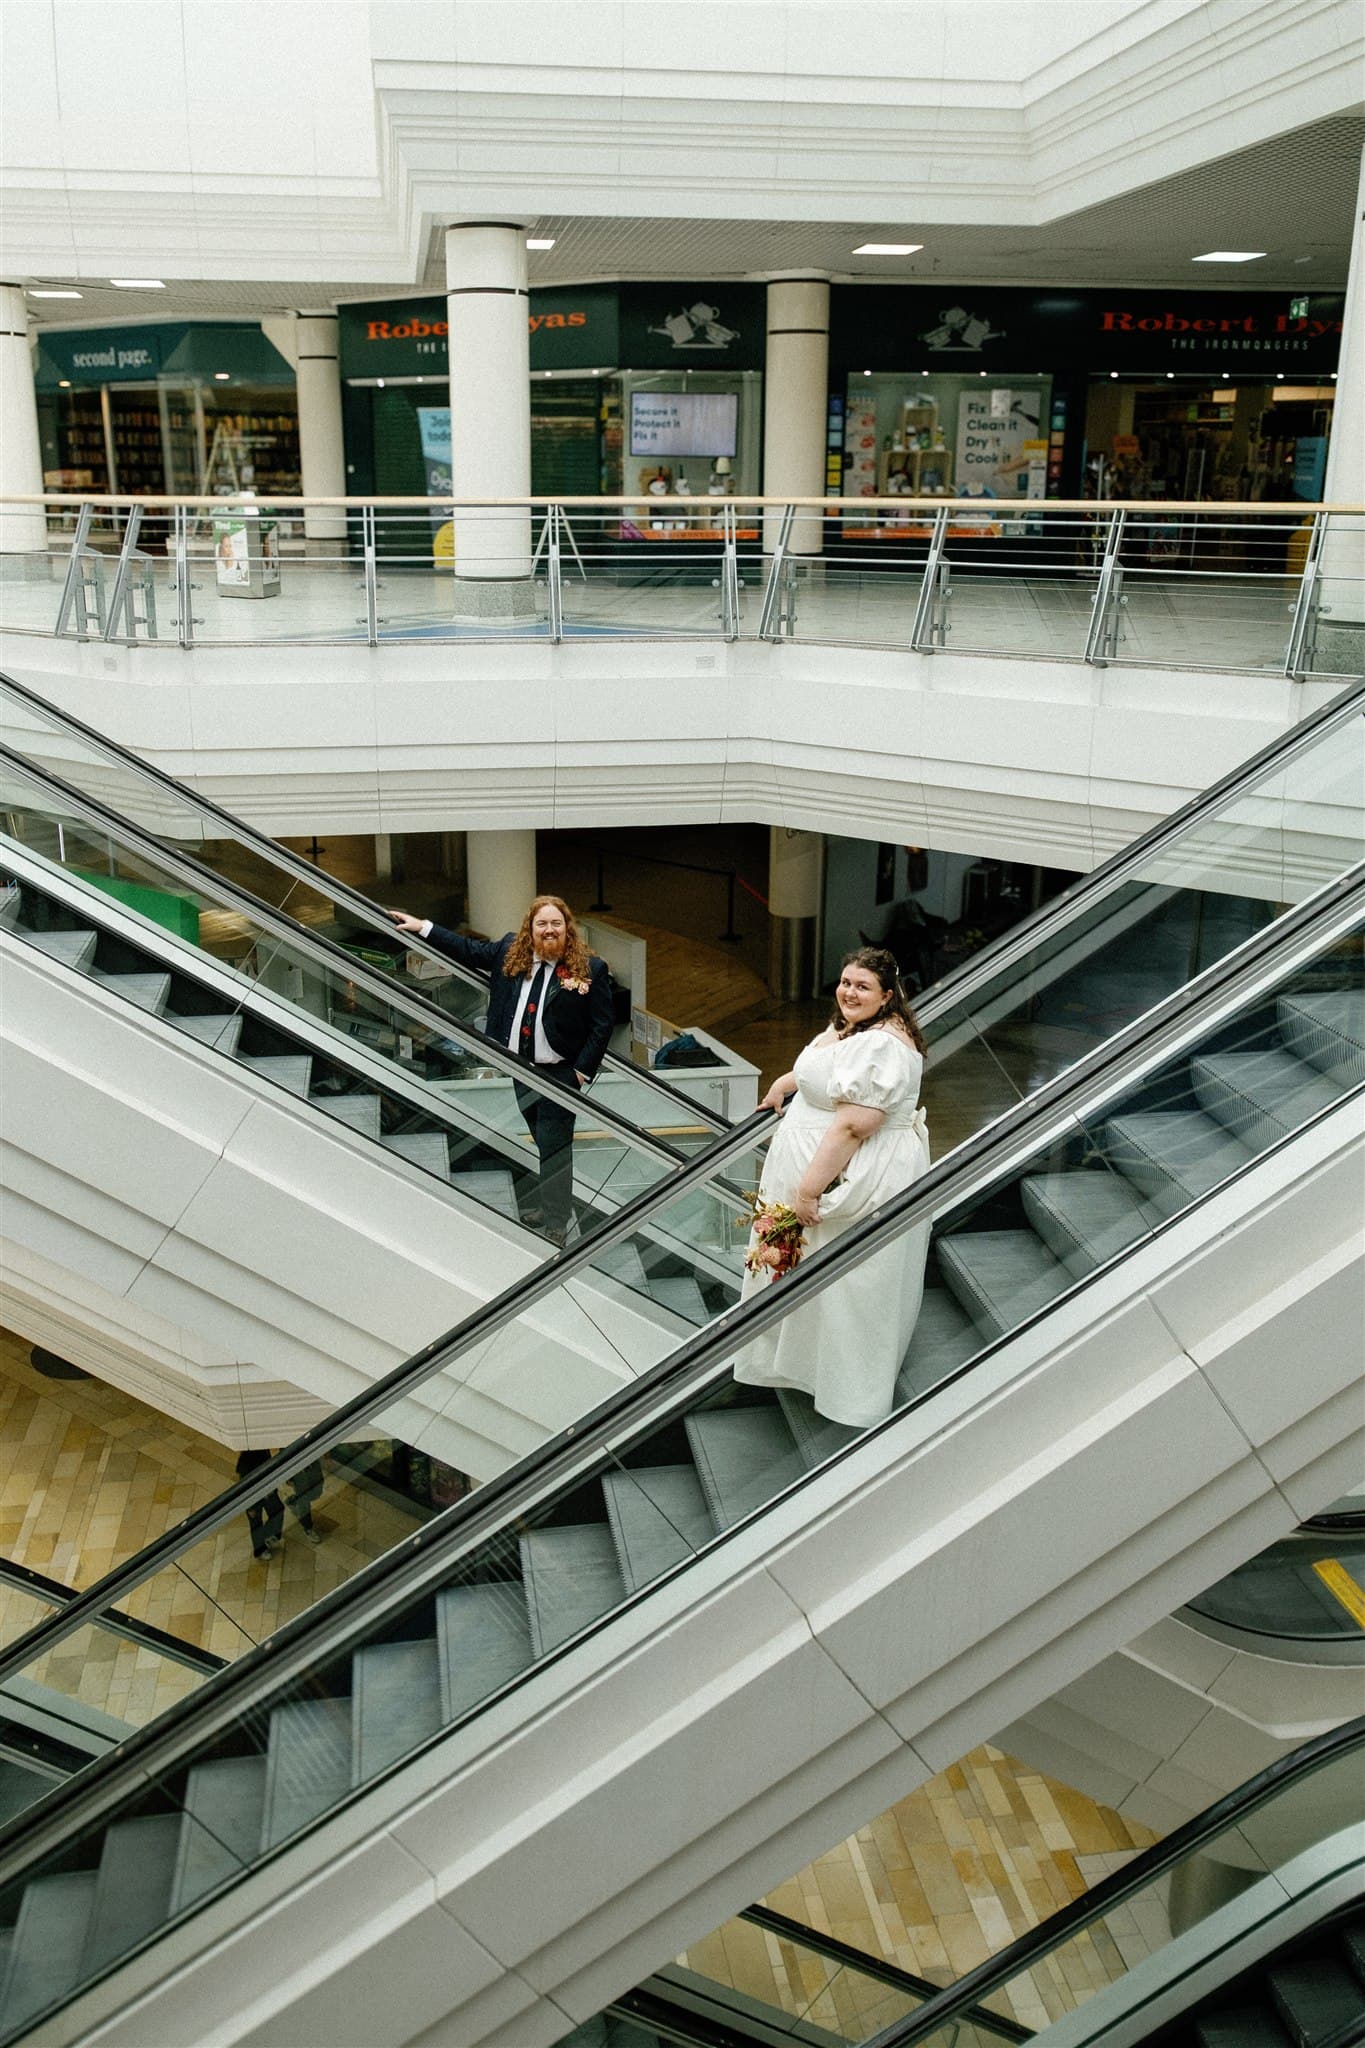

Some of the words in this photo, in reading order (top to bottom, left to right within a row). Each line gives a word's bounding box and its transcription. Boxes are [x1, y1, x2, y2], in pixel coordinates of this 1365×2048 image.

[366, 317, 448, 340] Robe
[1098, 311, 1259, 334] Robert
[1172, 339, 1196, 350] THE
[1205, 339, 1309, 351] IRONMONGERS
[73, 347, 116, 368] second
[634, 406, 668, 416] Secure
[671, 406, 678, 416] it
[967, 402, 987, 415] Fix
[634, 418, 671, 429] Protect
[673, 419, 681, 429] it
[966, 418, 1006, 431] Clean
[1008, 418, 1018, 431] it
[634, 431, 648, 441] Fix
[651, 432, 658, 441] it
[965, 436, 989, 450] Dry
[964, 452, 998, 465] Cook
[1002, 452, 1012, 465] it
